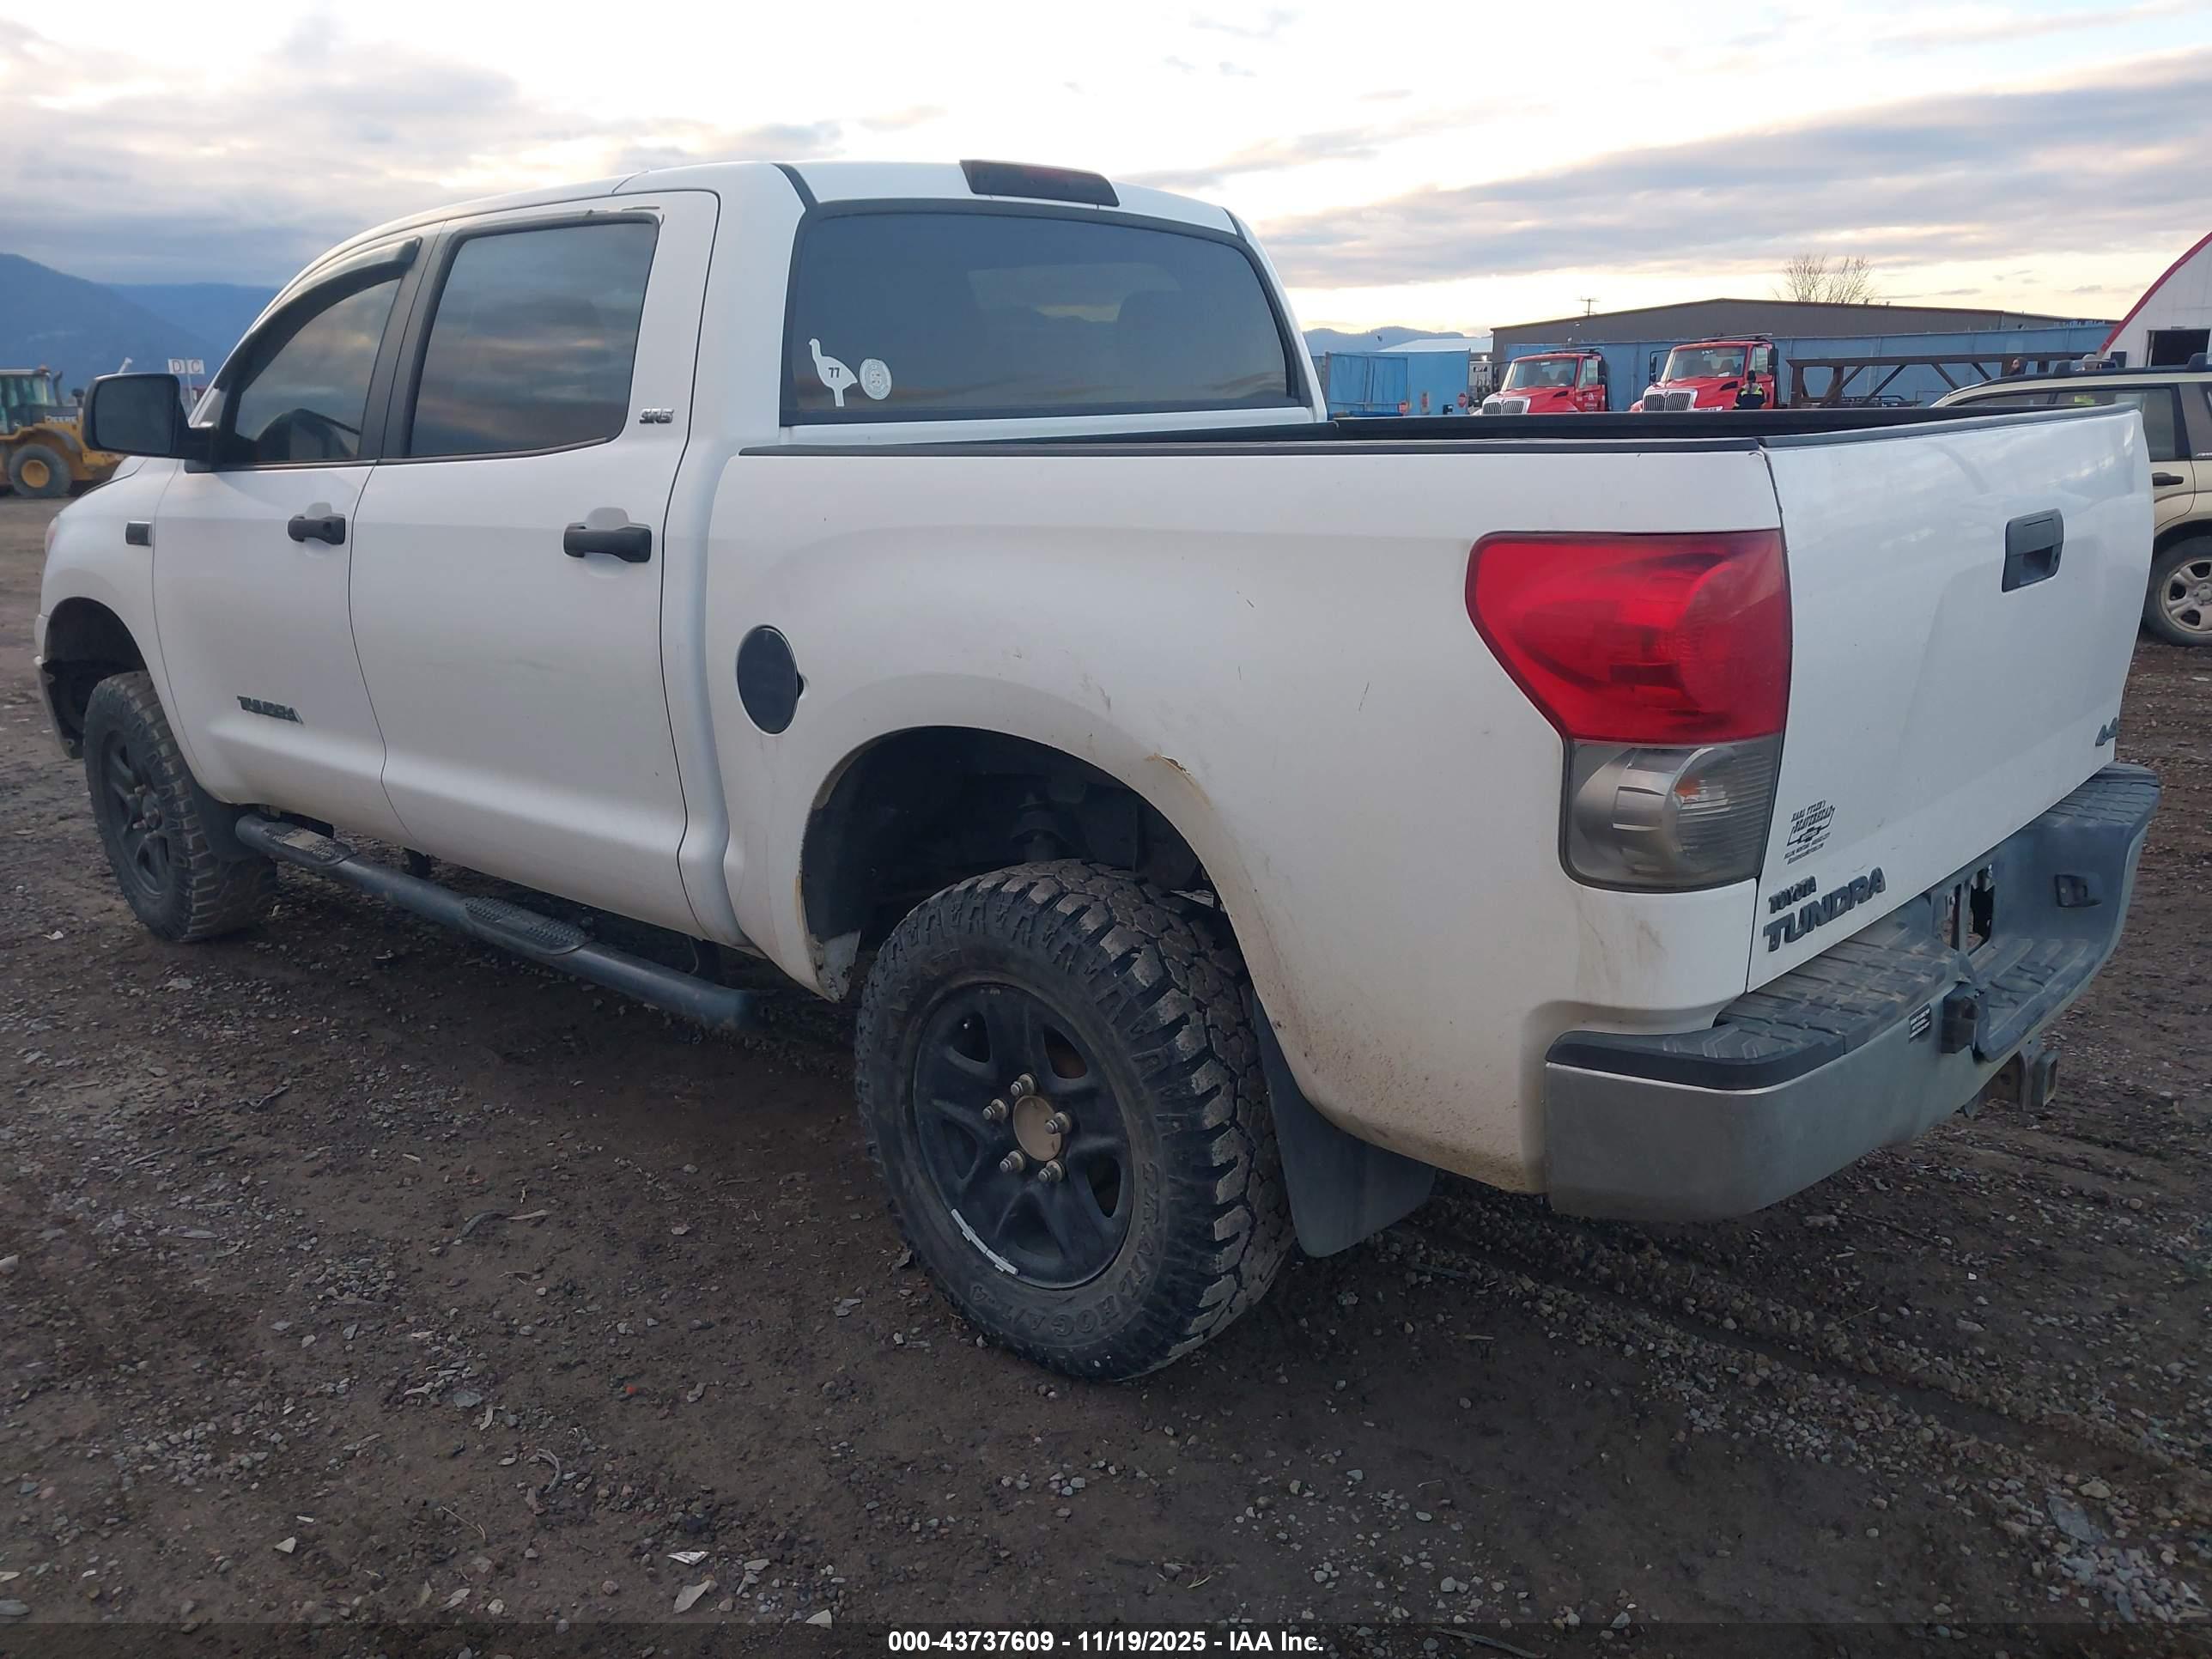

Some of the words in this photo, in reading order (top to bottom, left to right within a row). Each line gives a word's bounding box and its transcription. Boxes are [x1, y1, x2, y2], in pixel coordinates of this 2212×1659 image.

[828, 367, 841, 379] 77
[236, 695, 304, 724] TUNDRA
[1763, 866, 1887, 953] TUNDRA
[1767, 875, 1817, 915] TOYOTA
